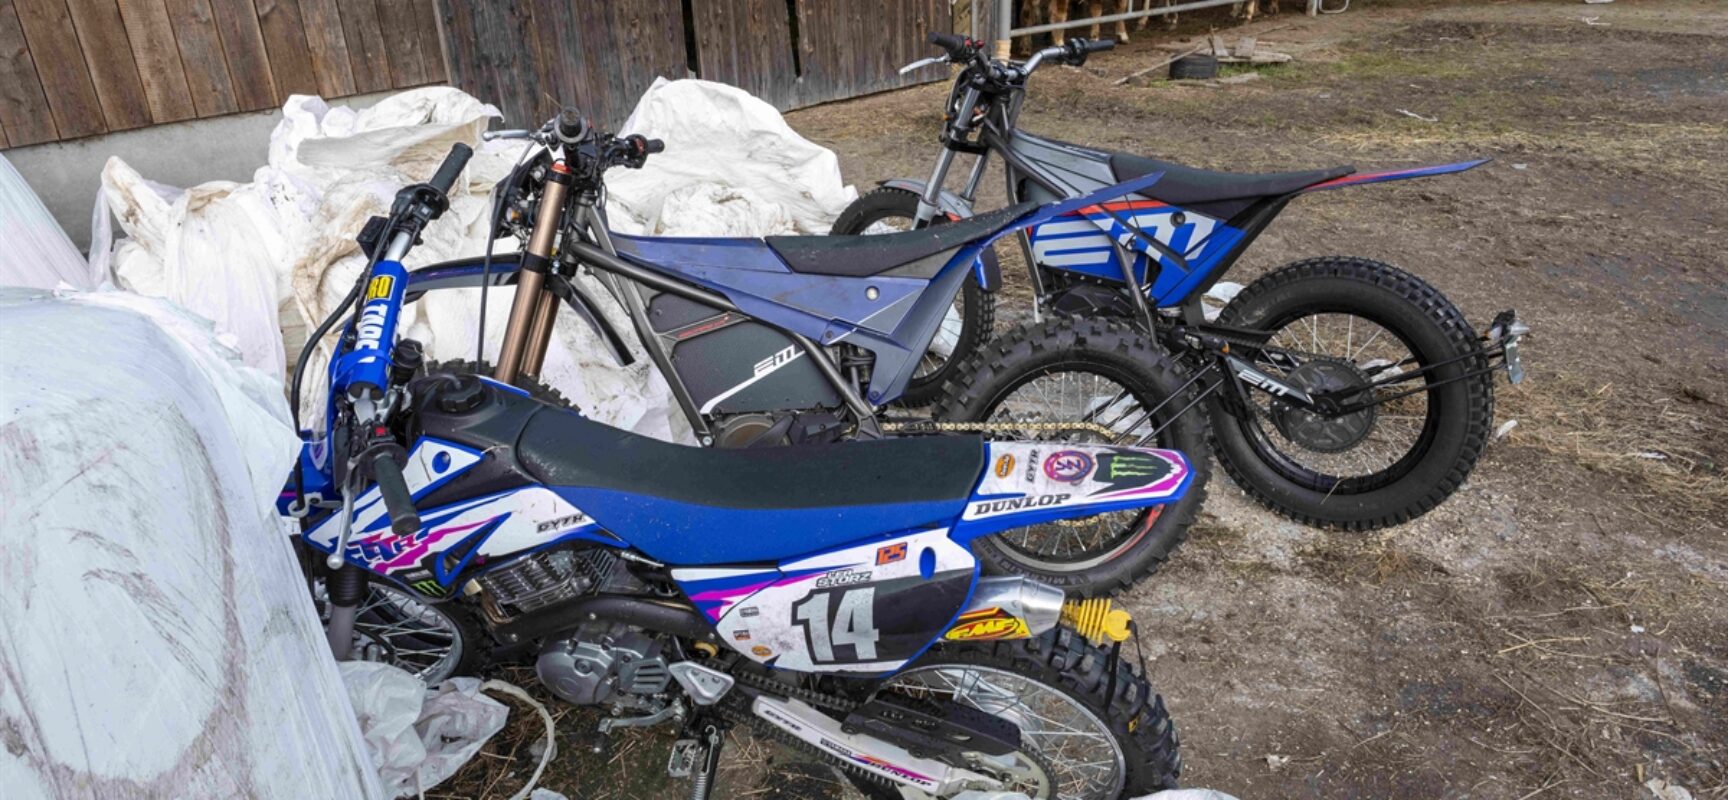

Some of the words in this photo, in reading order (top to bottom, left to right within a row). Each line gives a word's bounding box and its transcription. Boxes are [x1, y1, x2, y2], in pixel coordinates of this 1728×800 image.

[365, 275, 392, 300] RO
[974, 493, 1071, 516] DUNLOP
[816, 571, 873, 588] STORZ
[792, 587, 880, 664] 14
[946, 618, 1016, 640] FMF
